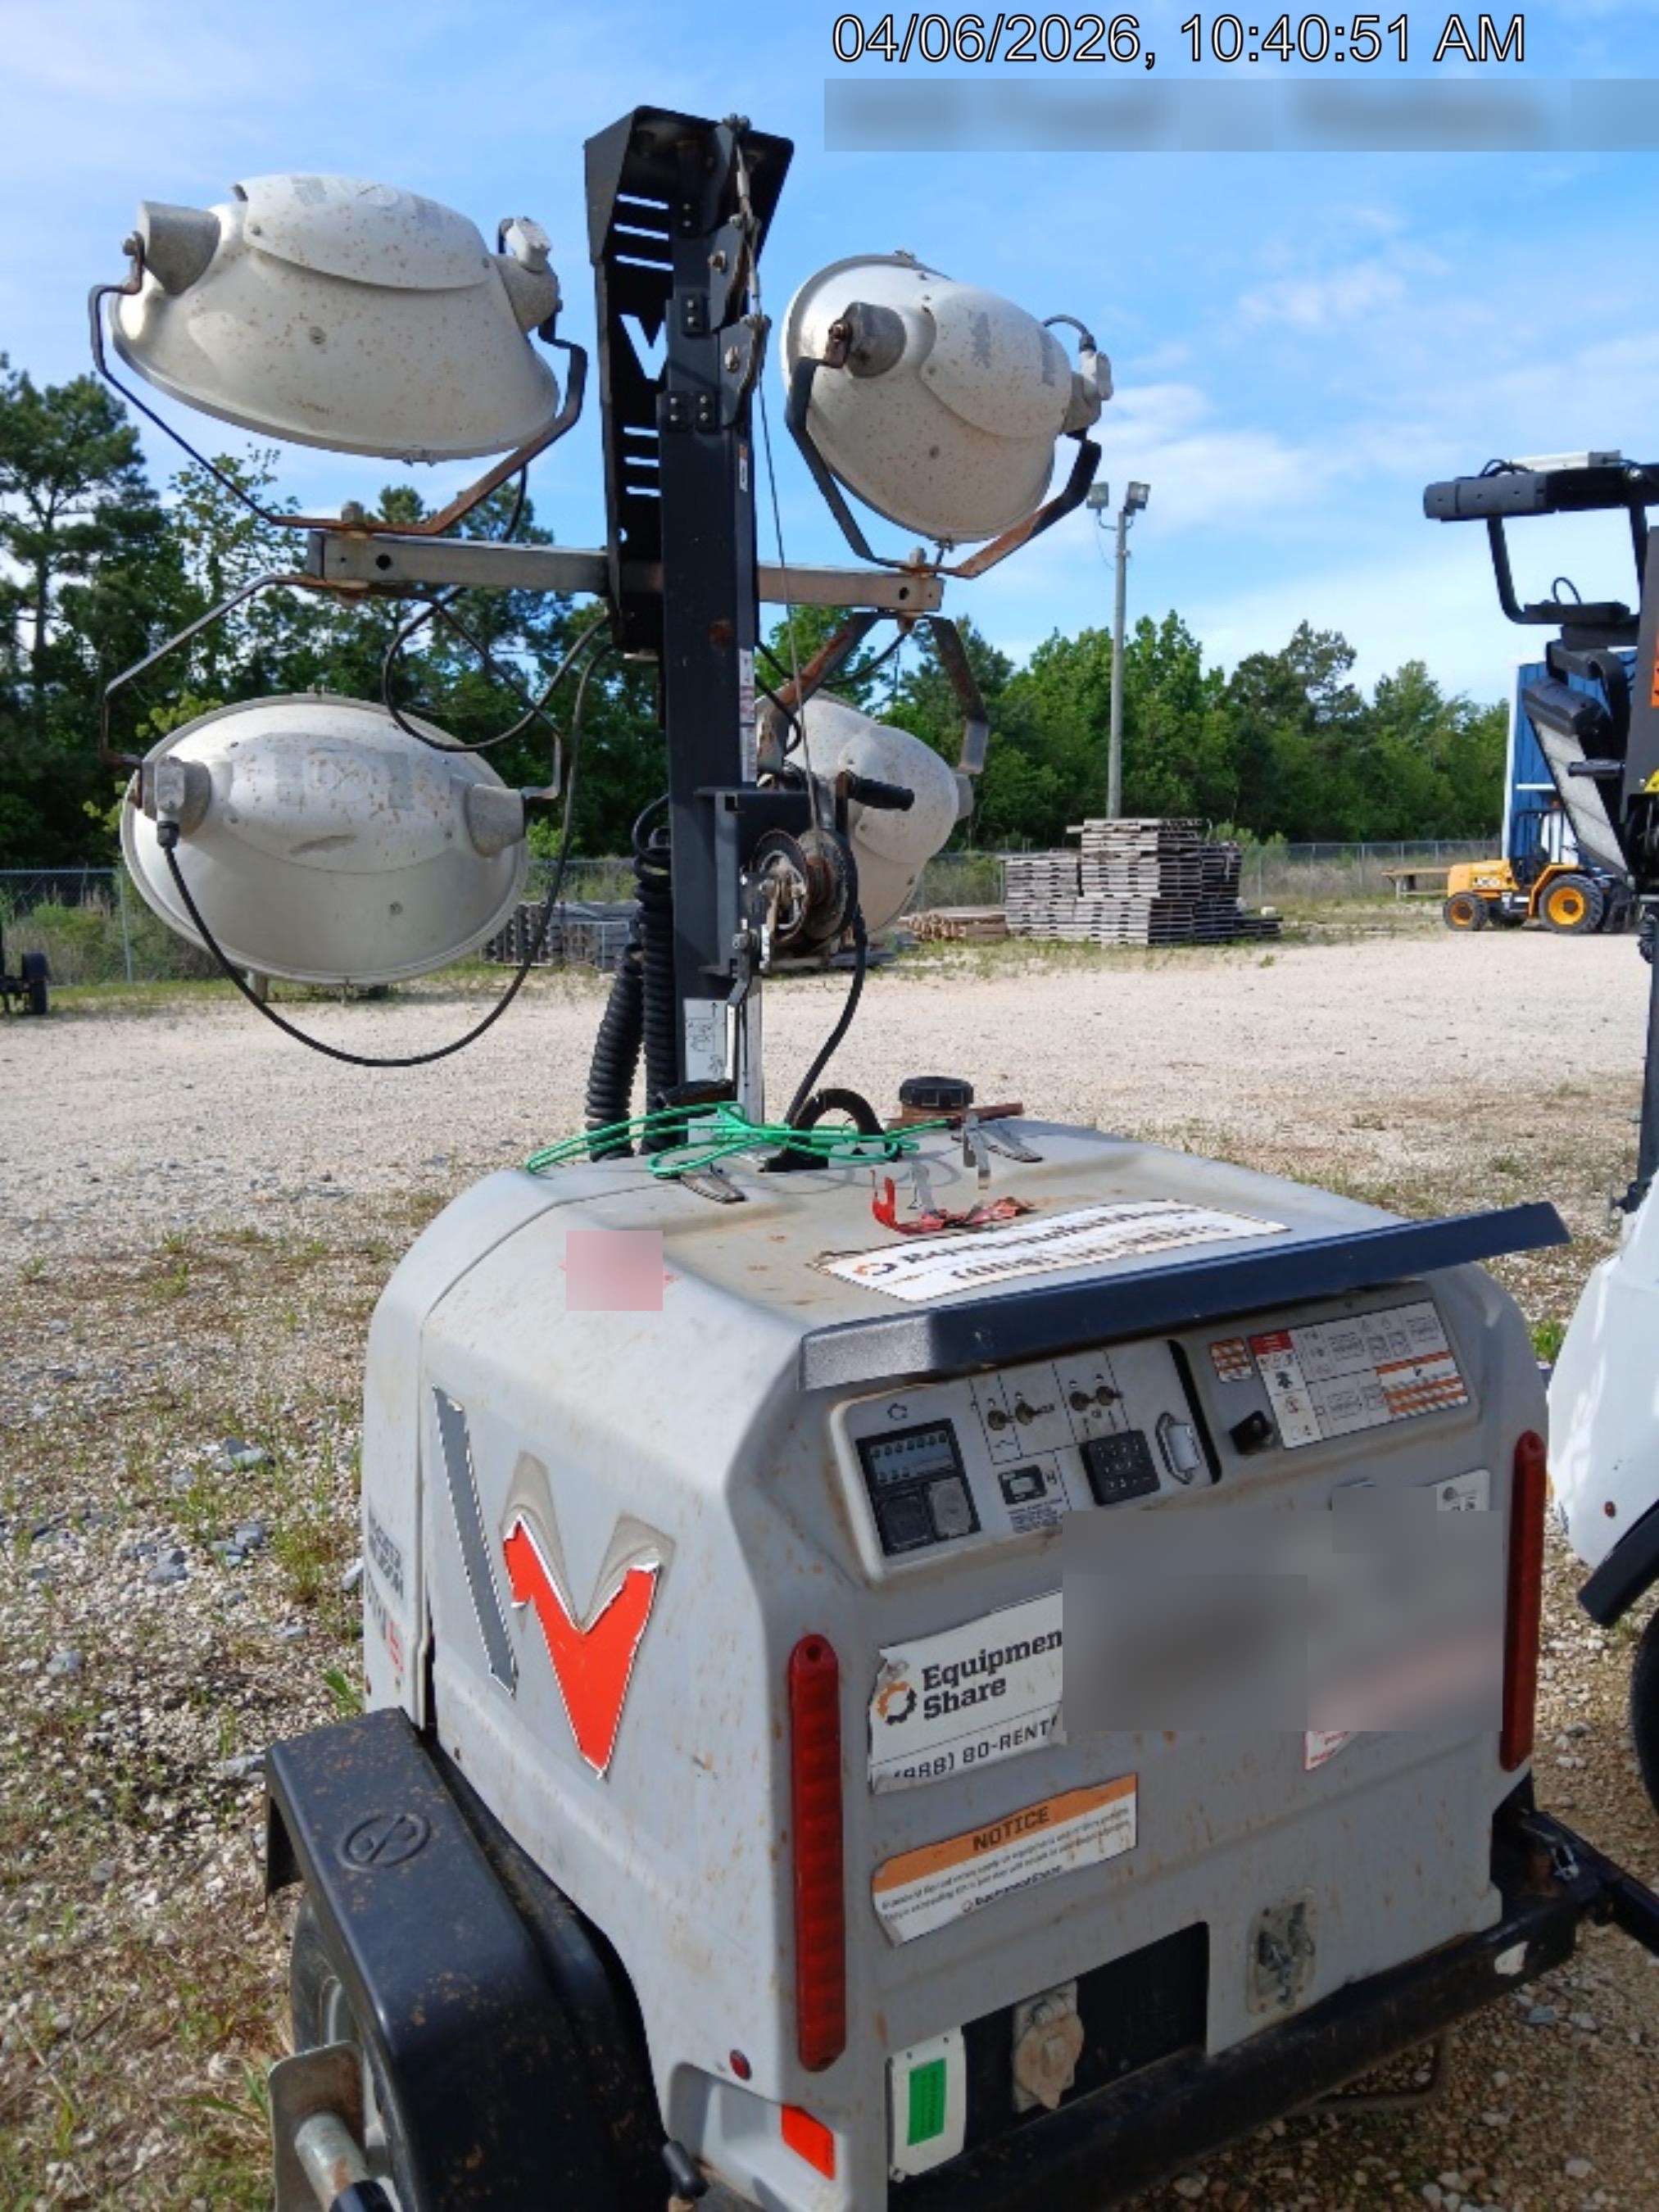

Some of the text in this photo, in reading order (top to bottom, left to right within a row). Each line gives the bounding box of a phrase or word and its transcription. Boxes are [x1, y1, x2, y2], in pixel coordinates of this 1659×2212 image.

[922, 1630, 1063, 1691] Equipmen
[923, 1678, 1007, 1720] Share
[972, 1806, 1050, 1852] NOTICE
